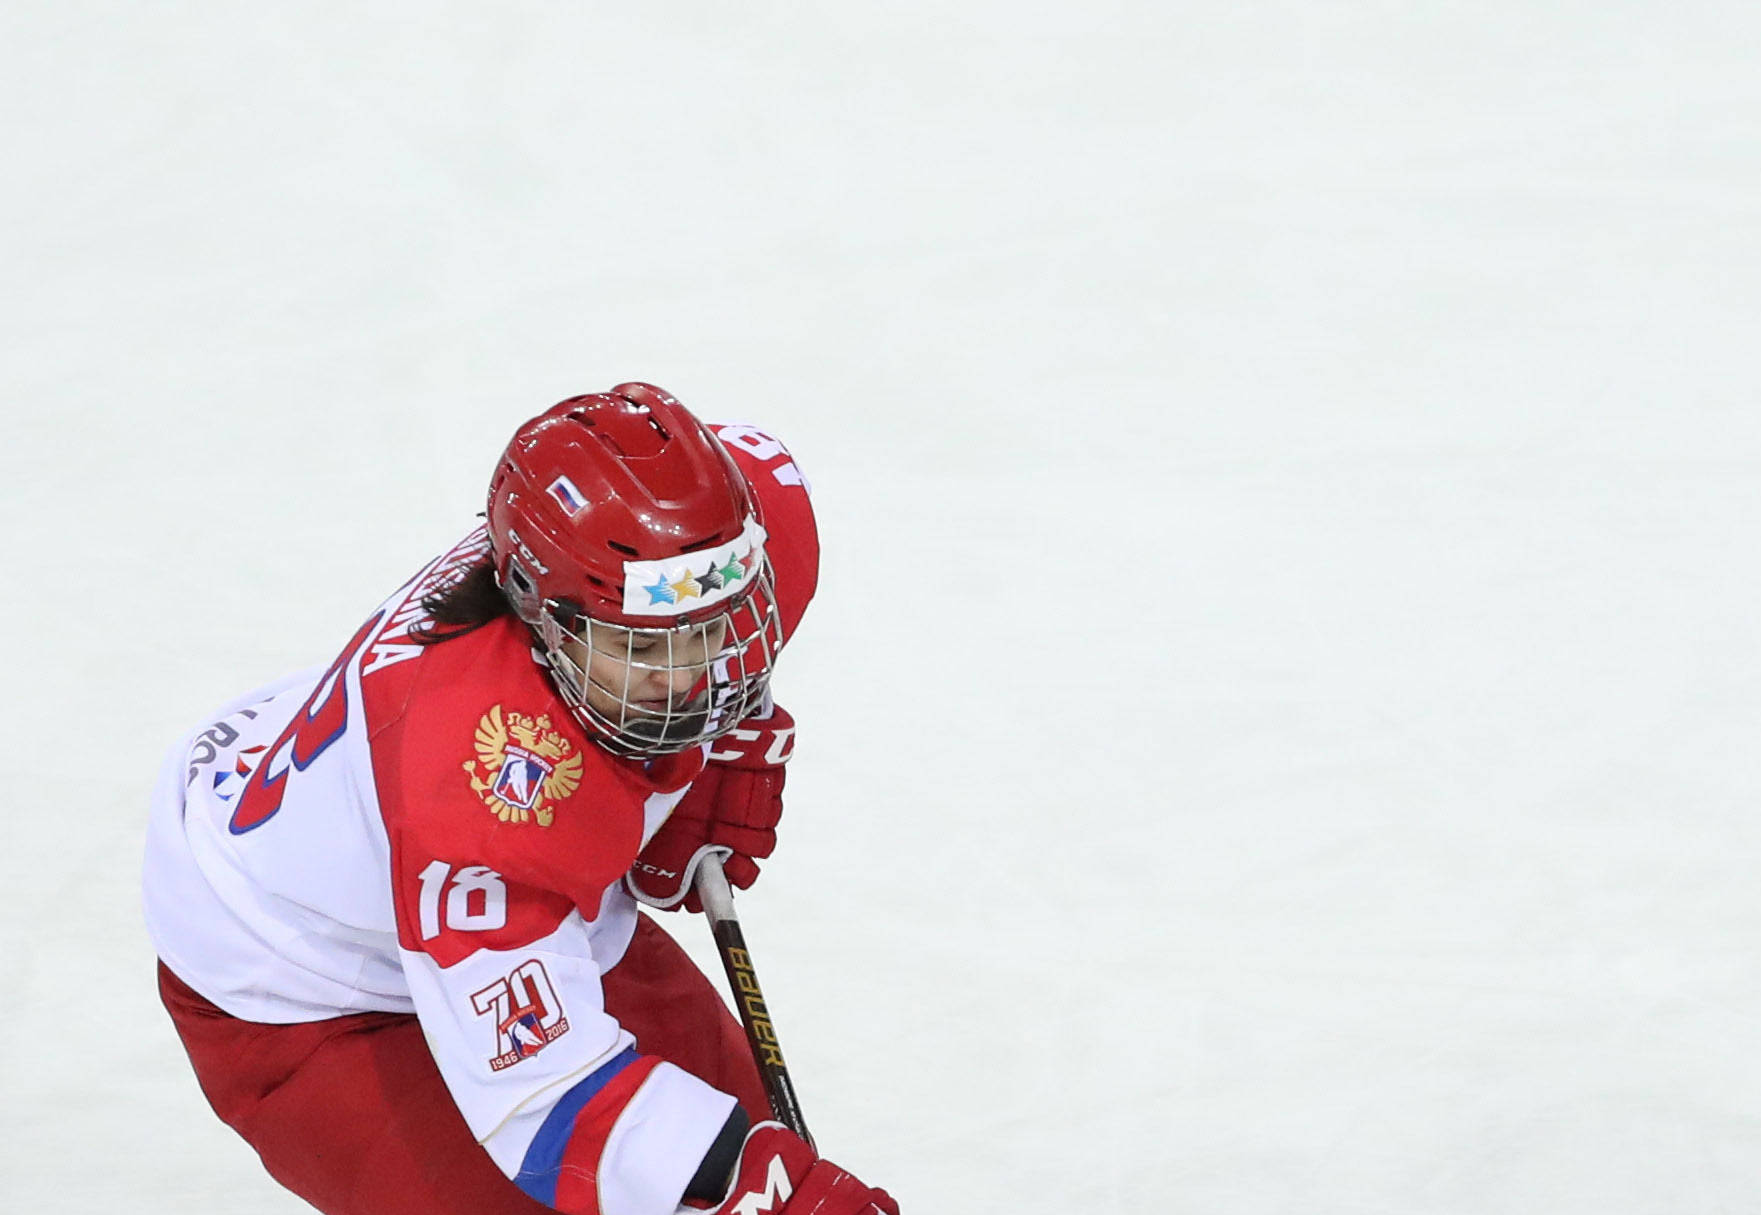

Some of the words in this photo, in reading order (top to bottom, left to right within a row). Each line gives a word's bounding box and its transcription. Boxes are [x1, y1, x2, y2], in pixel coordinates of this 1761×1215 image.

[508, 528, 550, 575] CCM
[417, 859, 508, 942] 18
[469, 958, 564, 1059] 70
[491, 1051, 519, 1071] 1946
[545, 1020, 569, 1042] 2016
[728, 946, 786, 1067] BAUER
